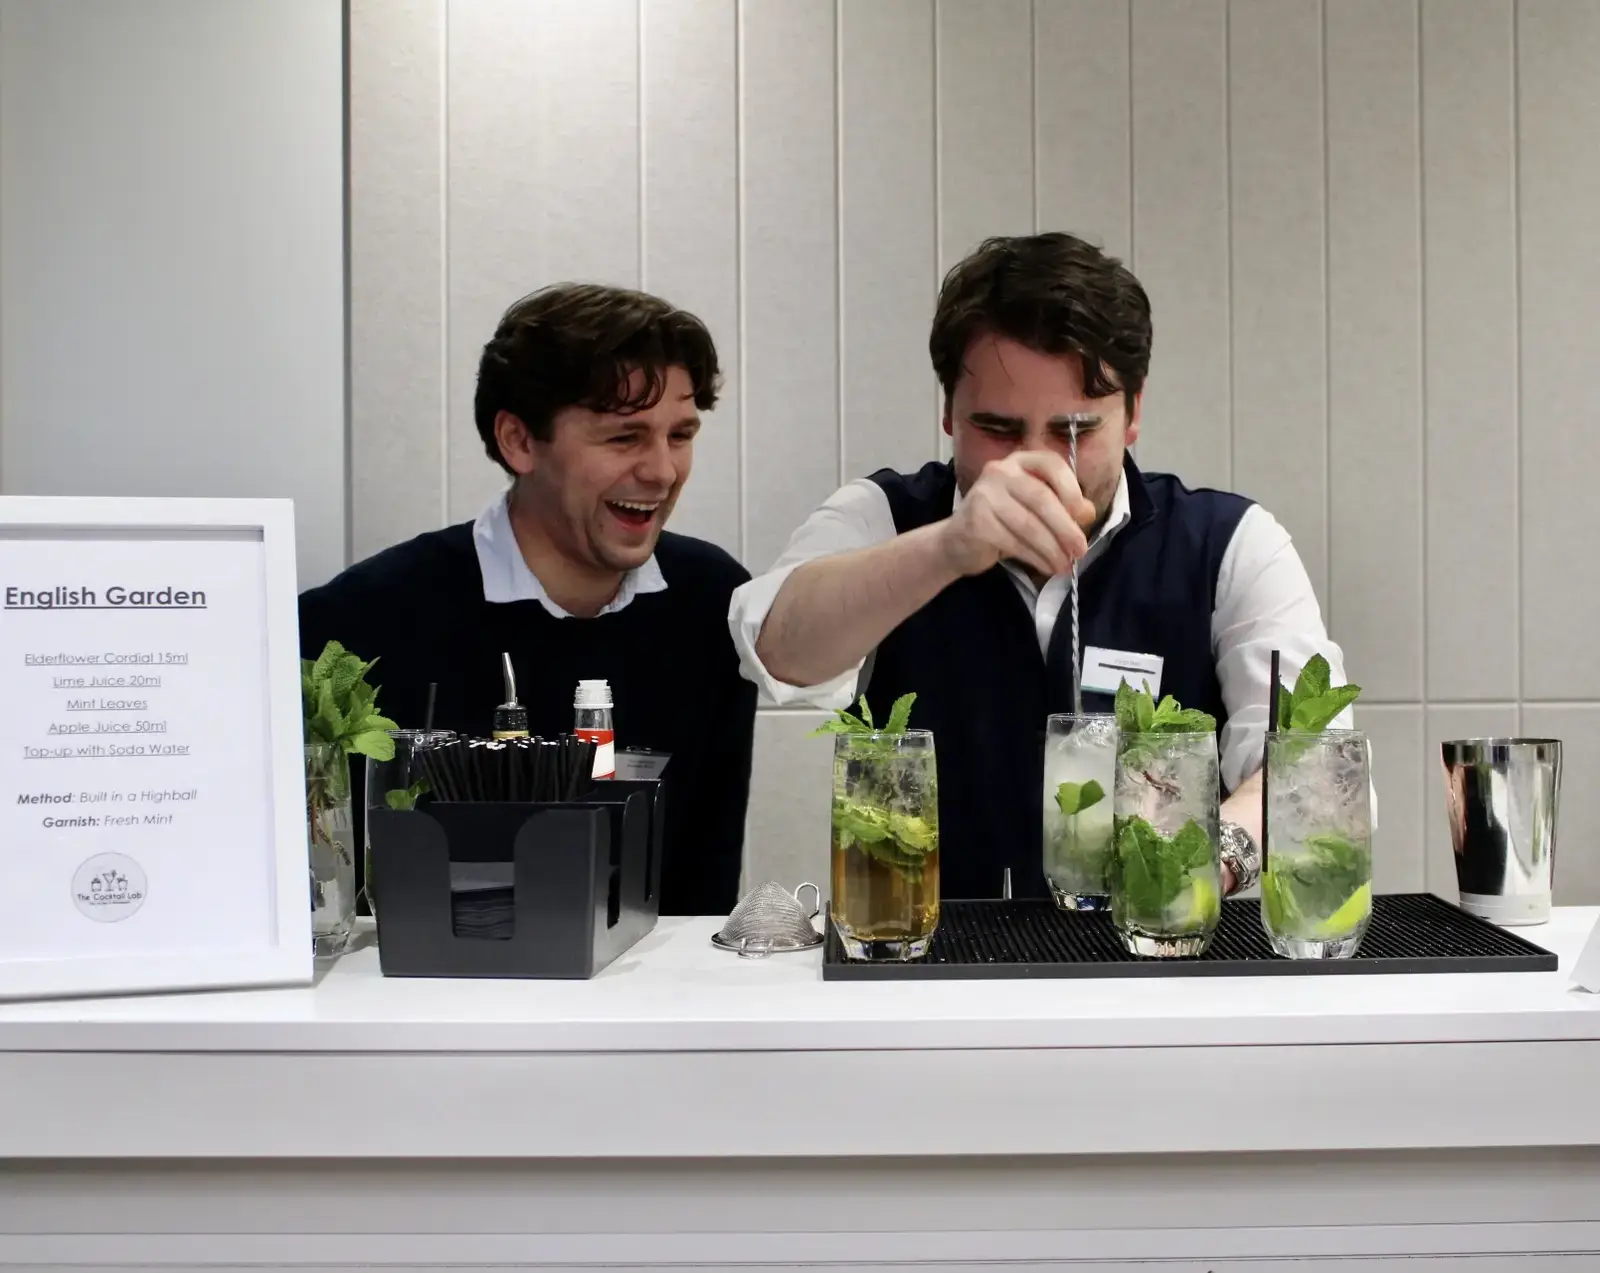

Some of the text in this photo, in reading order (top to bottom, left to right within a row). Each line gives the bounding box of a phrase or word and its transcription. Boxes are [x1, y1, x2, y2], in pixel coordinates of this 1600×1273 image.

[5, 586, 207, 609] English Garden
[24, 652, 188, 664] Elderflower Cordial 15ml
[53, 675, 161, 687] Lime Juice 20ml
[67, 698, 148, 709] Mint Leaves
[48, 721, 166, 734] Apple Juice 50ml
[24, 743, 190, 758] Top-up with Soda Water
[17, 789, 197, 804] Method: Built in a Highball
[42, 814, 172, 828] Garnish: Fresh Mint
[94, 893, 125, 901] Cocktail
